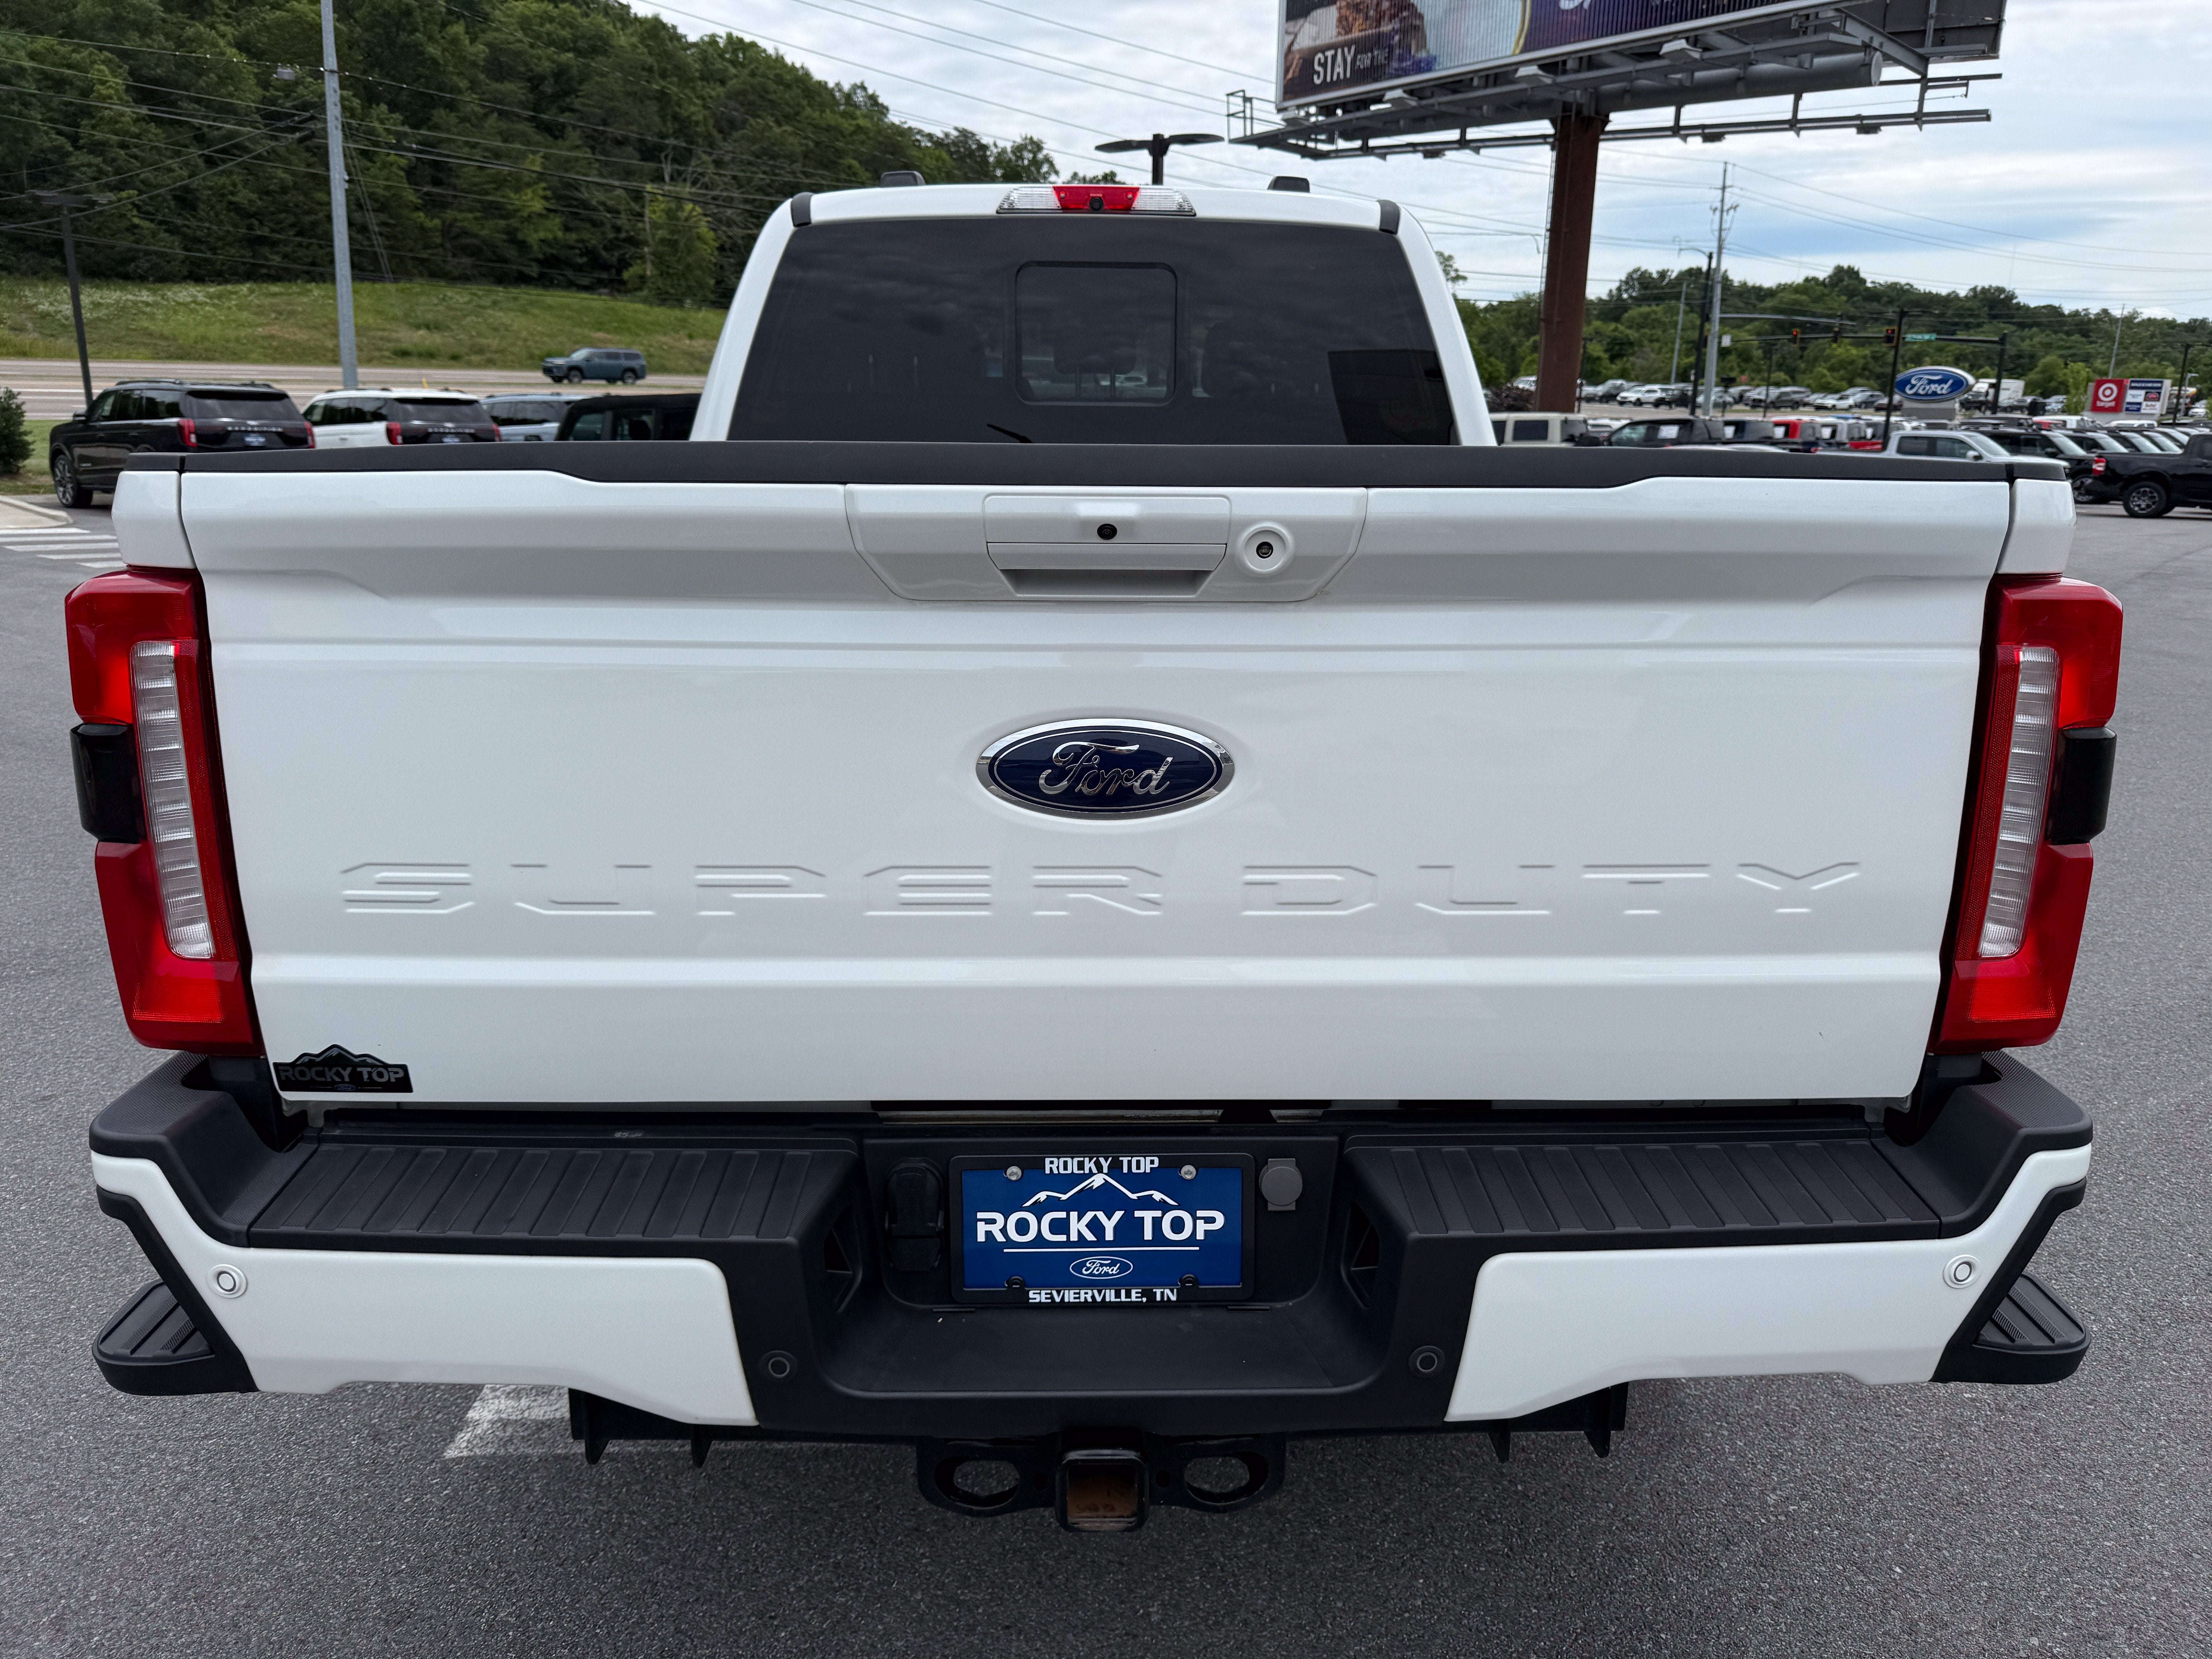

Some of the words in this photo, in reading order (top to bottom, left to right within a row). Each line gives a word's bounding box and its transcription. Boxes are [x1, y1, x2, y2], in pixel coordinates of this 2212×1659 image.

[1313, 45, 1355, 85] STAY
[1905, 374, 1954, 395] Ford
[1039, 741, 1174, 795] Ford
[340, 862, 1162, 915] SUPER
[1242, 862, 1860, 915] DUTY
[278, 1066, 352, 1082] ROCKY
[357, 1067, 404, 1082] TOP
[1045, 1157, 1112, 1174] ROCKY
[1119, 1156, 1159, 1173] TOP
[977, 1211, 1125, 1242] ROCKY
[1134, 1210, 1225, 1240] TOP
[1082, 1260, 1120, 1275] Ford
[1029, 1289, 1147, 1303] SEVIERVILLE,
[1153, 1288, 1177, 1302] TN
